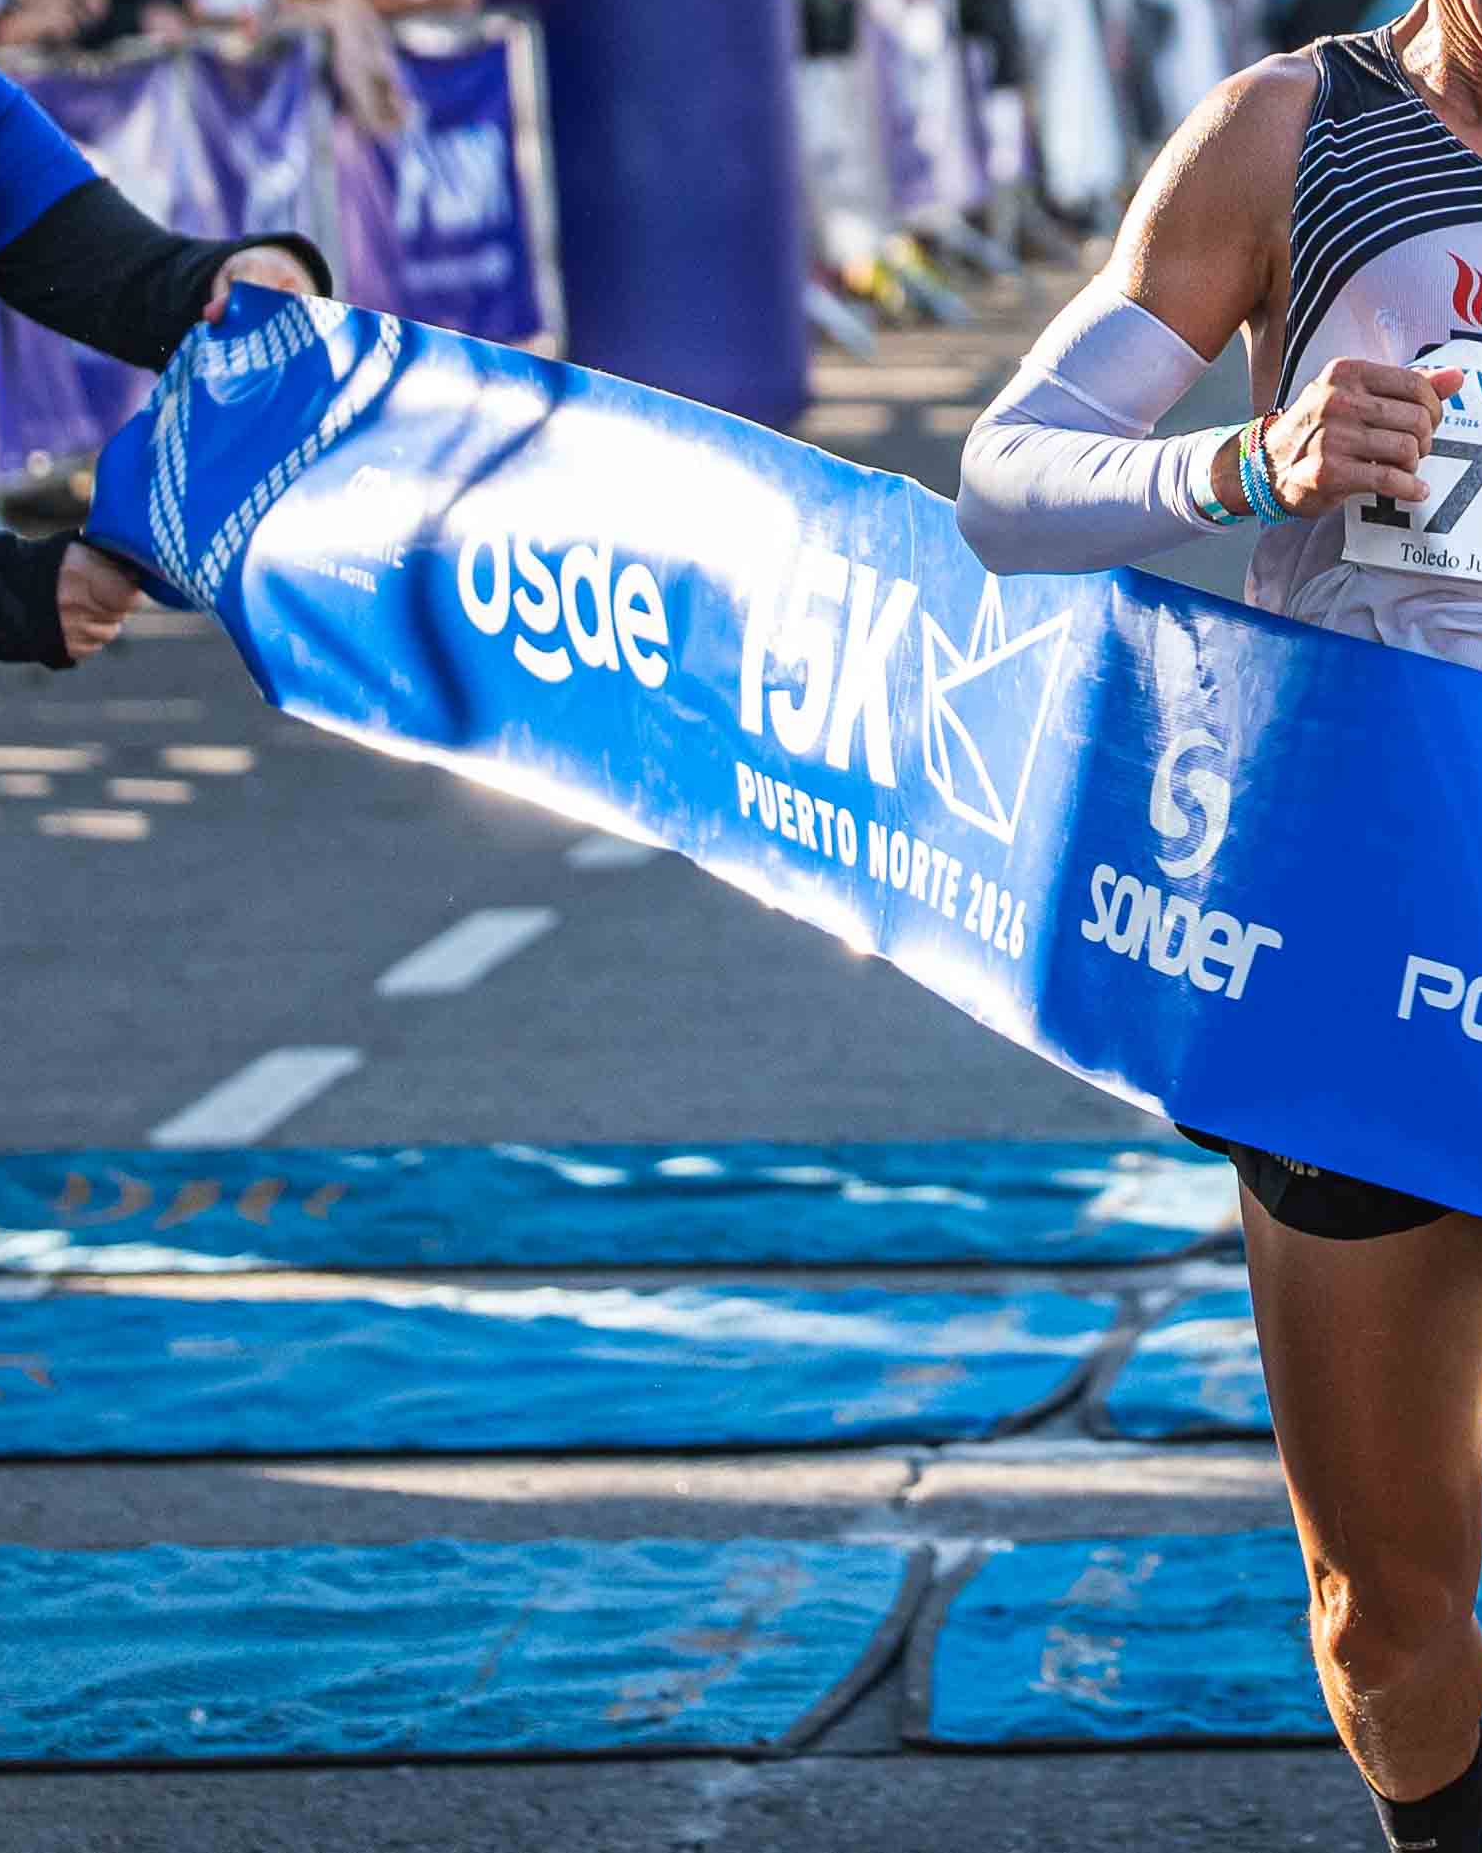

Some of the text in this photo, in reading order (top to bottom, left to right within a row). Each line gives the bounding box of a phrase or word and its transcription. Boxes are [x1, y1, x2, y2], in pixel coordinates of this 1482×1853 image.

[1400, 542, 1460, 568] Toledo
[737, 548, 918, 788] 15K
[735, 761, 1027, 960] PUERTO NORTE 2026
